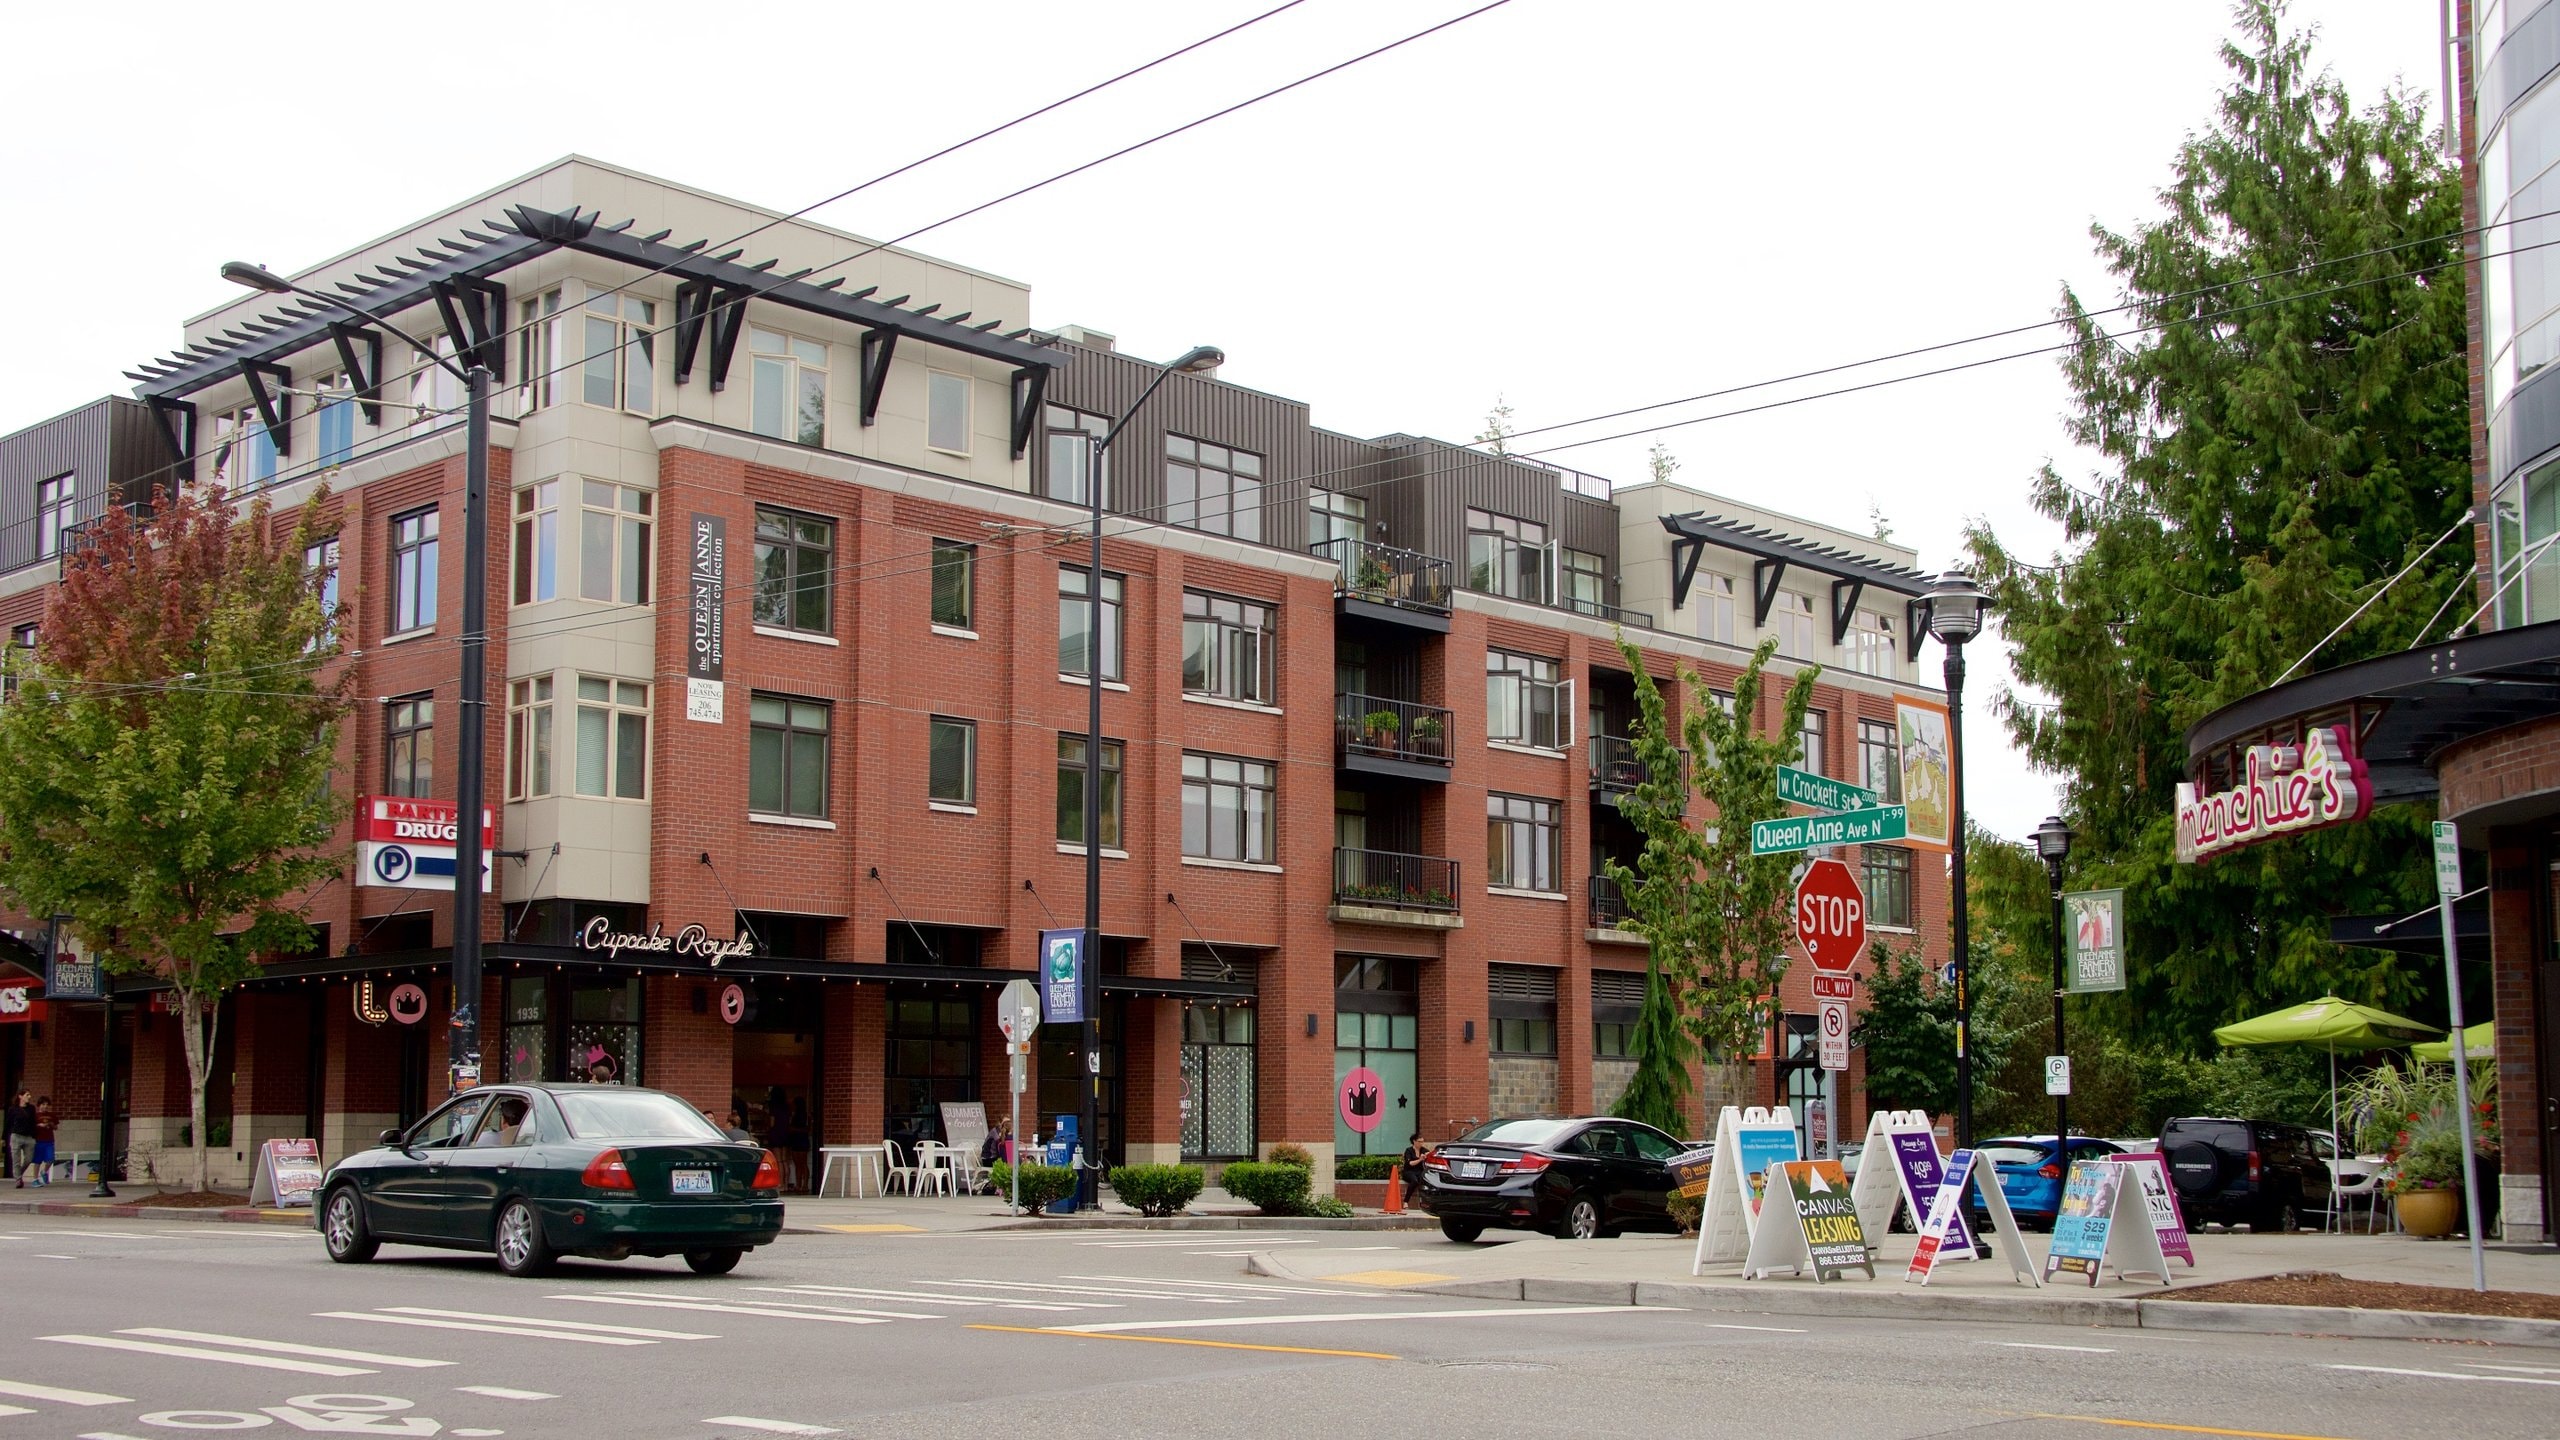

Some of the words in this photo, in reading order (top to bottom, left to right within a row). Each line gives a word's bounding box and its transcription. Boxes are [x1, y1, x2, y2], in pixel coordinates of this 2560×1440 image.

[697, 521, 710, 573] ANNE
[712, 538, 722, 599] collection
[694, 584, 711, 652] QUEEN
[698, 657, 707, 671] the
[698, 682, 713, 690] NOW
[689, 688, 722, 698] LEASING
[699, 700, 712, 709] 206
[1792, 773, 1838, 808] Crockett
[1841, 794, 1851, 811] St
[1861, 790, 1877, 804] 2000
[2179, 731, 2342, 854] menchie's
[386, 802, 457, 821] BARTE
[394, 821, 457, 840] DRUG
[1757, 824, 1802, 849] Queen
[1806, 820, 1844, 843] Anne
[1847, 822, 1868, 839] Ave
[1872, 819, 1881, 836] N
[1801, 892, 1861, 937] STOP
[585, 915, 671, 959] Cupcake
[676, 923, 754, 967] Royale
[2077, 951, 2098, 961] QUEEN
[2098, 950, 2117, 960] ANNE
[56, 964, 77, 973] QUEEN
[2078, 960, 2116, 972] FARMERS
[56, 973, 94, 984] FARMERS
[1049, 984, 1063, 993] QUEEN
[1063, 983, 1076, 992] ANNE
[1816, 980, 1830, 993] ALL
[1834, 981, 1851, 995] WAY
[1050, 992, 1076, 1003] FARMERS
[517, 1007, 539, 1020] 1935
[1825, 1041, 1843, 1050] WITHIN
[1823, 1052, 1830, 1061] 30
[1832, 1053, 1845, 1061] FEET
[944, 1107, 983, 1118] SUMMER
[1667, 1152, 1697, 1165] SUMMER
[1692, 1163, 1712, 1173] WATT
[2071, 1166, 2082, 1182] Try
[1683, 1183, 1708, 1195] REGIST
[1796, 1197, 1855, 1216] CANVAS
[2151, 1213, 2175, 1222] ETHER
[1802, 1216, 1862, 1244] LEASING
[2083, 1220, 2106, 1233] $29
[2086, 1233, 2104, 1242] weeks
